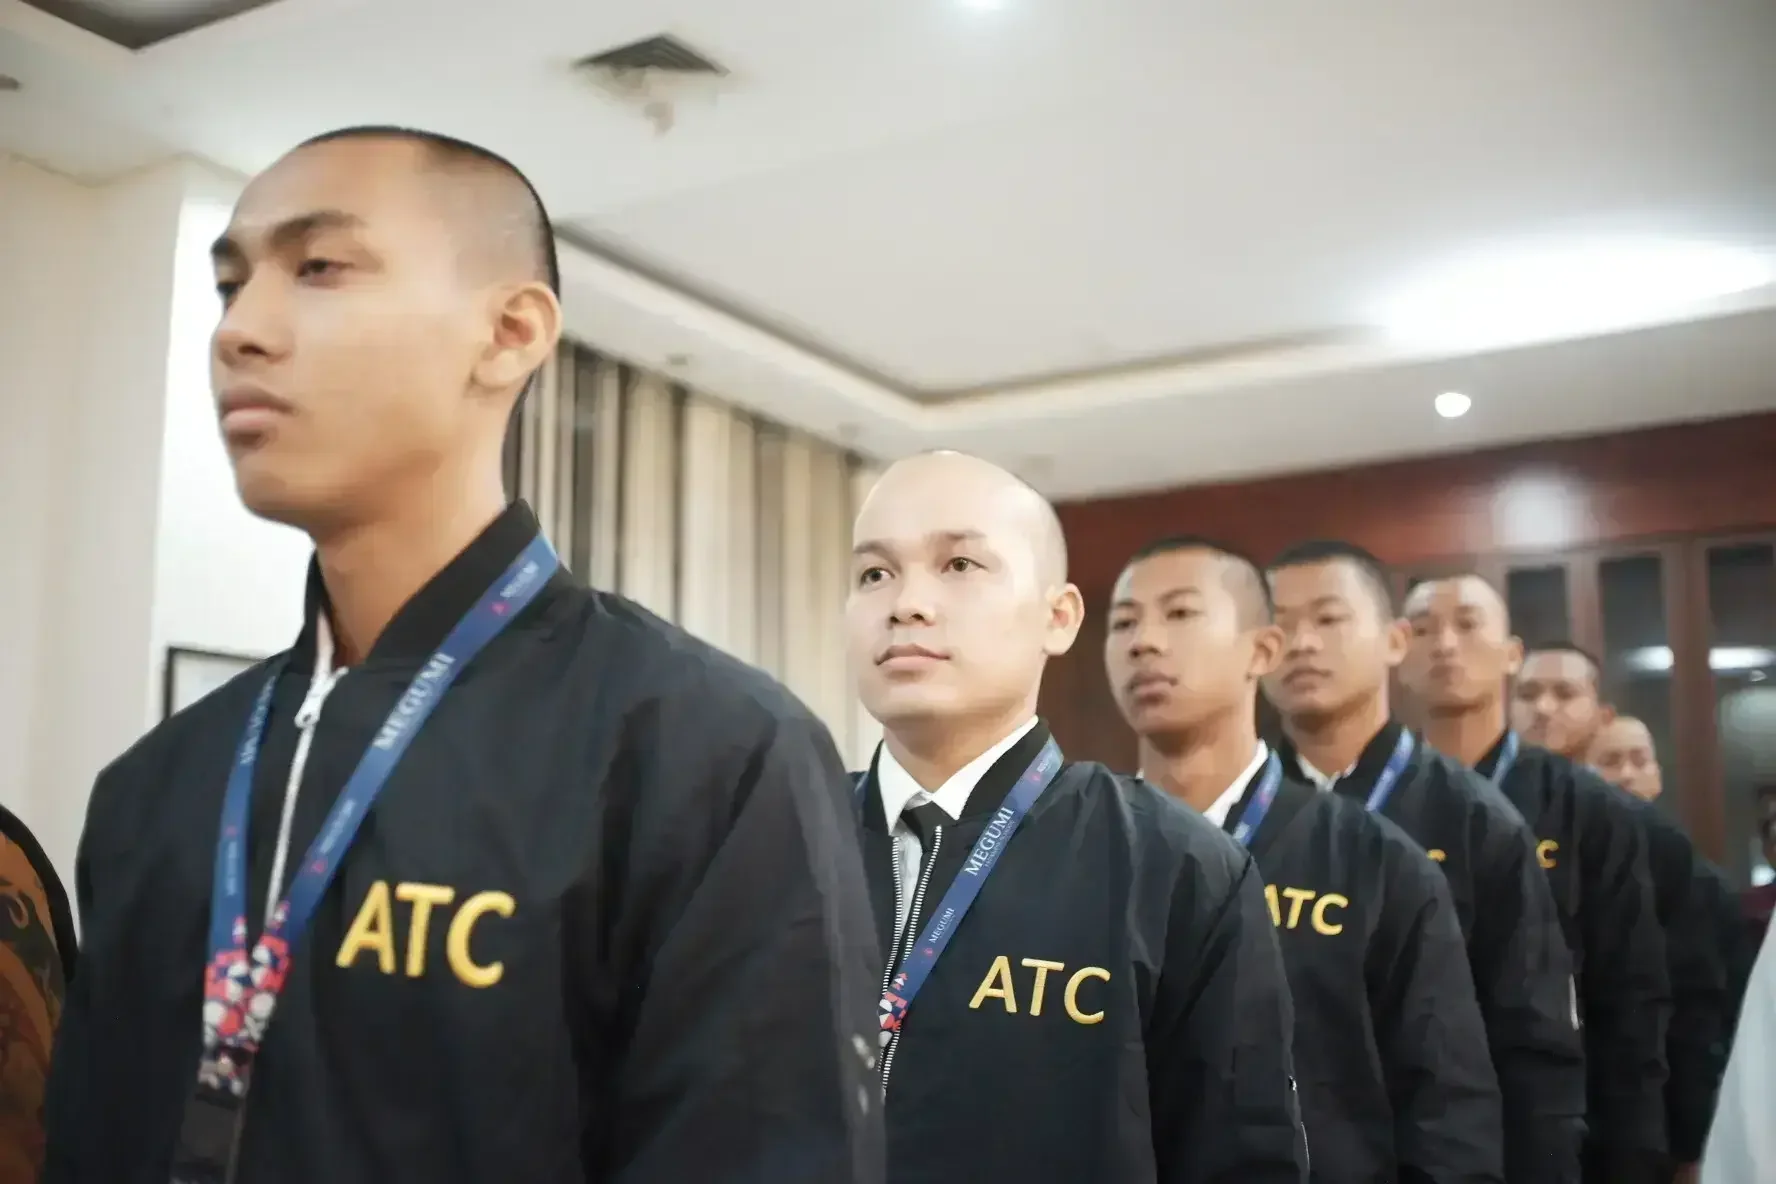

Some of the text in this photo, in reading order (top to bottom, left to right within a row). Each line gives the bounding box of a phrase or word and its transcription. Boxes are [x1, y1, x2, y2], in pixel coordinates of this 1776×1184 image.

[372, 652, 456, 750] MEGUMI
[964, 806, 1014, 876] MEGUMI
[335, 879, 516, 989] ATC
[928, 907, 955, 944] MEGUMI
[968, 955, 1111, 1025] ATC
